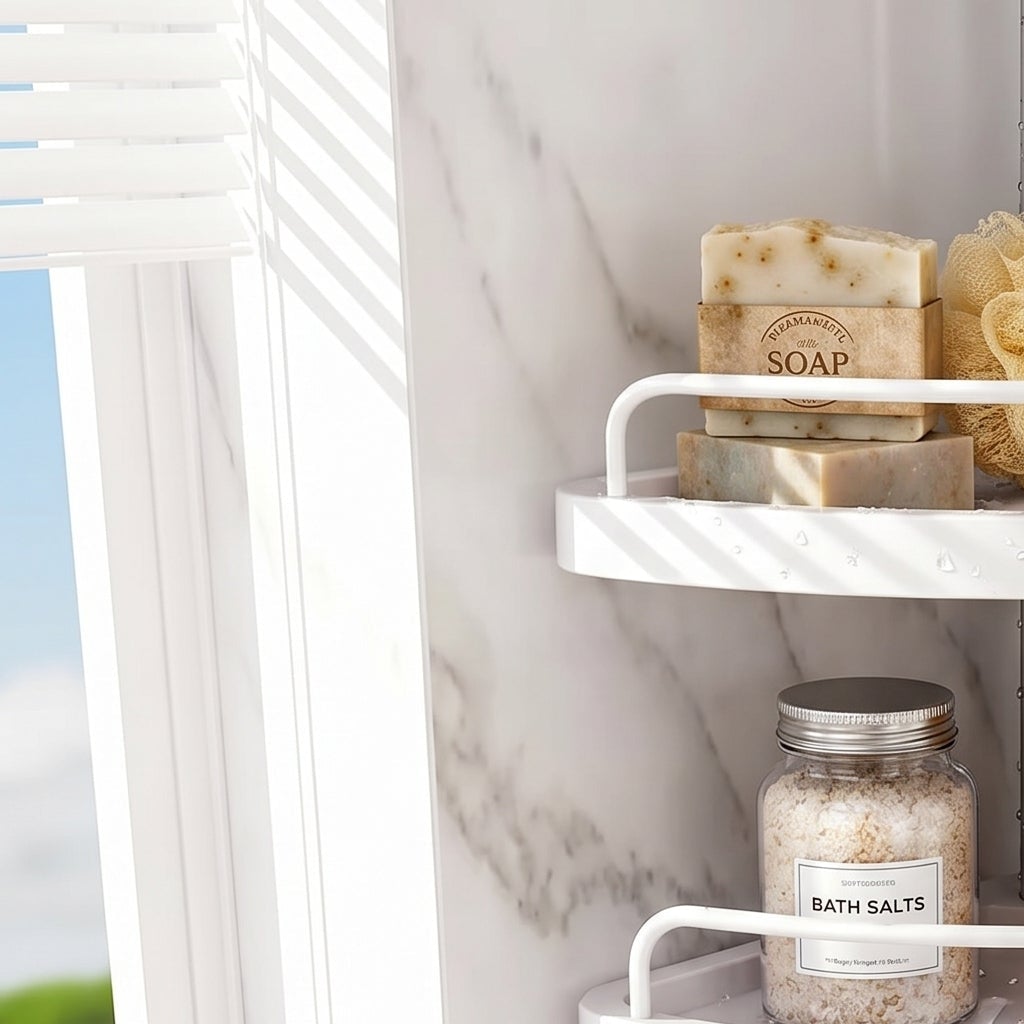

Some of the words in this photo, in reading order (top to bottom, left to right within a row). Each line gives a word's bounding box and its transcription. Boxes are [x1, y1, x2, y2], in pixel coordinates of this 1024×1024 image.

[767, 351, 849, 375] SOAP
[812, 896, 860, 914] BATH
[867, 896, 925, 914] SALTS
